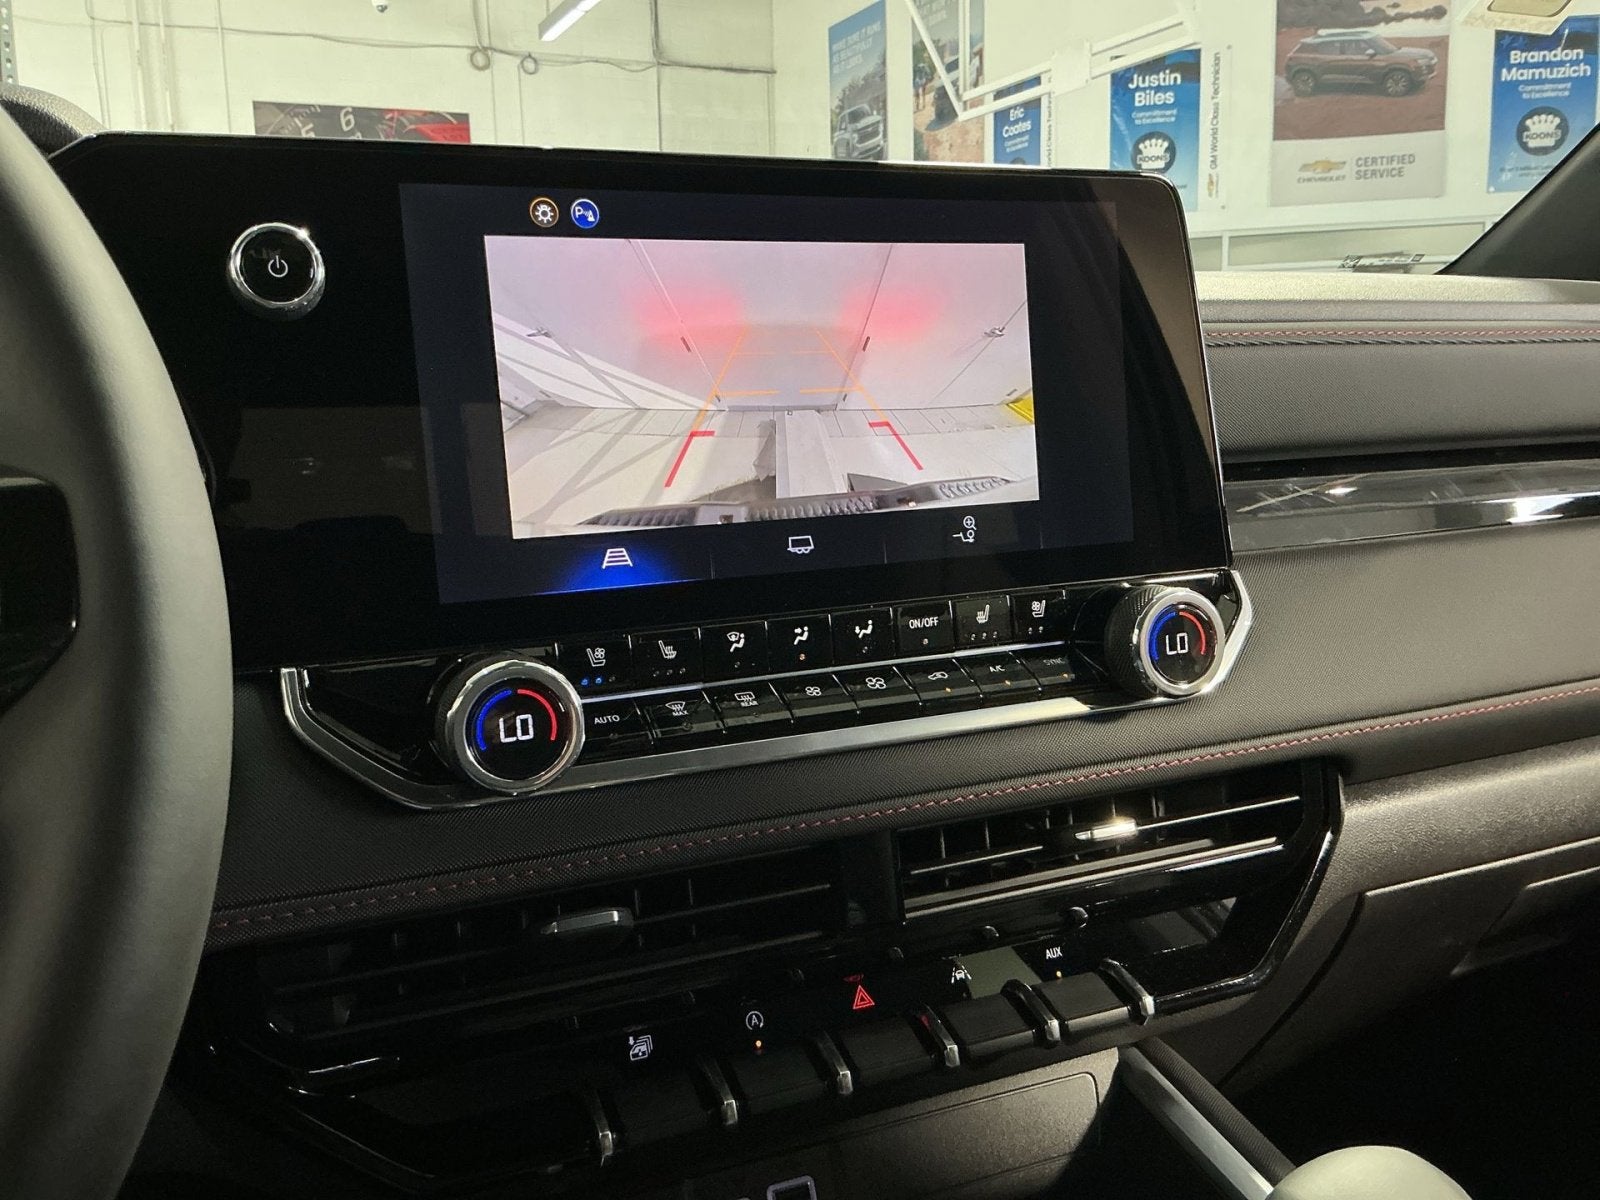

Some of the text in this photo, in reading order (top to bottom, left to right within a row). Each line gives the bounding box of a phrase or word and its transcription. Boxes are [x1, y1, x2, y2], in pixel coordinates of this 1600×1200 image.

[1509, 46, 1584, 64] Brandon
[1128, 69, 1181, 89] Justin
[1210, 52, 1220, 100] Technician
[1501, 63, 1591, 81] Mamuzich
[1518, 82, 1572, 92] Commitment
[1531, 90, 1570, 99] Excellence
[1134, 89, 1175, 107] Biles
[339, 106, 355, 132] 6
[1009, 106, 1025, 121] Eric
[1210, 102, 1219, 126] Class
[1002, 120, 1032, 138] Coates
[1524, 131, 1561, 141] KOONS
[1210, 127, 1219, 154] World
[1138, 154, 1169, 163] KOONS
[1209, 154, 1218, 170] GM
[1355, 153, 1416, 168] CERTIFIED
[1355, 166, 1405, 181] SERVICE
[908, 616, 939, 629] ON/OFF
[1165, 632, 1189, 655] LO
[989, 664, 1006, 673] A/C
[740, 700, 759, 708] REAR
[593, 714, 621, 725] AUTO
[672, 709, 689, 717] MAX
[499, 713, 534, 743] LO
[1045, 946, 1063, 960] AUX
